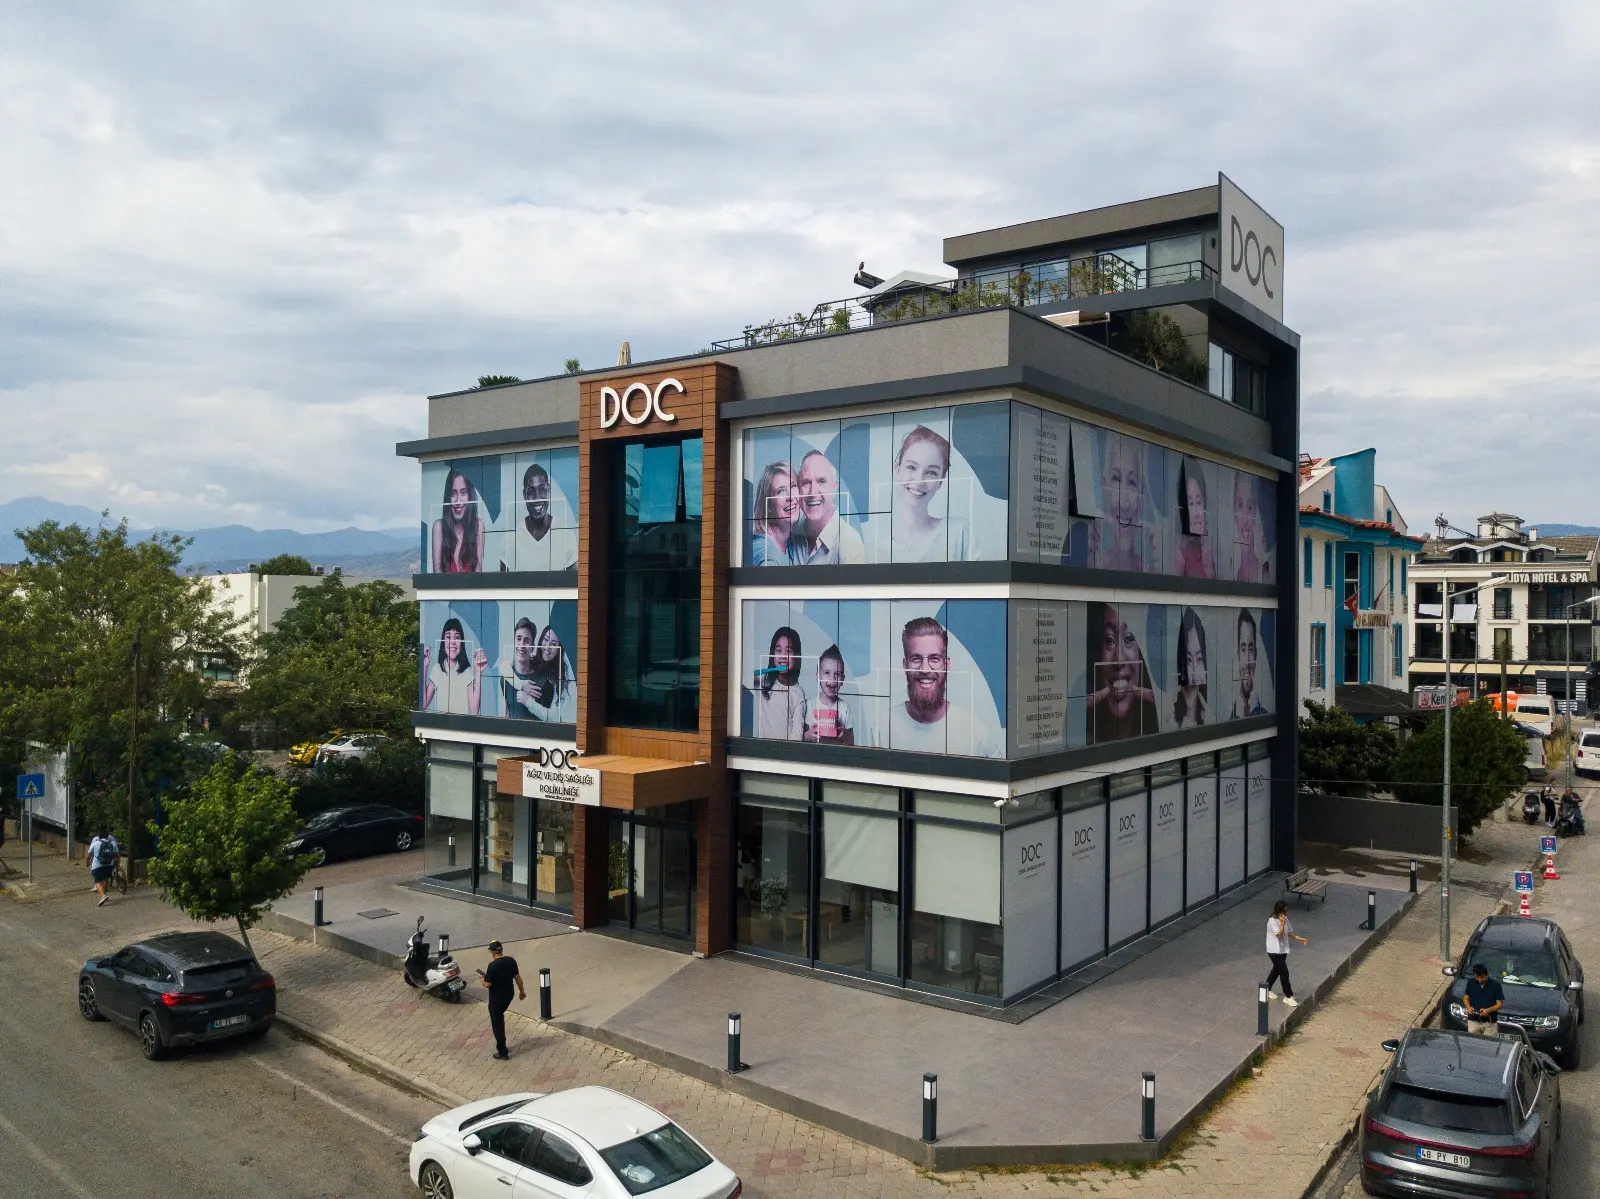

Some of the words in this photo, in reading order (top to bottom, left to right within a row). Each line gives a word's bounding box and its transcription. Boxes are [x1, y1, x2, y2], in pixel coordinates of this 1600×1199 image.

[1231, 214, 1276, 299] DOC
[600, 378, 684, 429] DOC
[1532, 572, 1558, 583] HOTEL
[1561, 573, 1567, 583] &
[1570, 572, 1588, 583] SPA
[540, 747, 578, 770] DOC
[527, 768, 542, 780] AĞIZ
[544, 772, 553, 781] VE
[554, 771, 564, 783] DİŞ
[564, 773, 594, 785] SAĞLIĞI
[1160, 803, 1173, 819] DOC
[1120, 814, 1136, 832] DOC
[1075, 827, 1093, 846] DOC
[1022, 843, 1043, 864] DOC
[1437, 1152, 1447, 1162] PY
